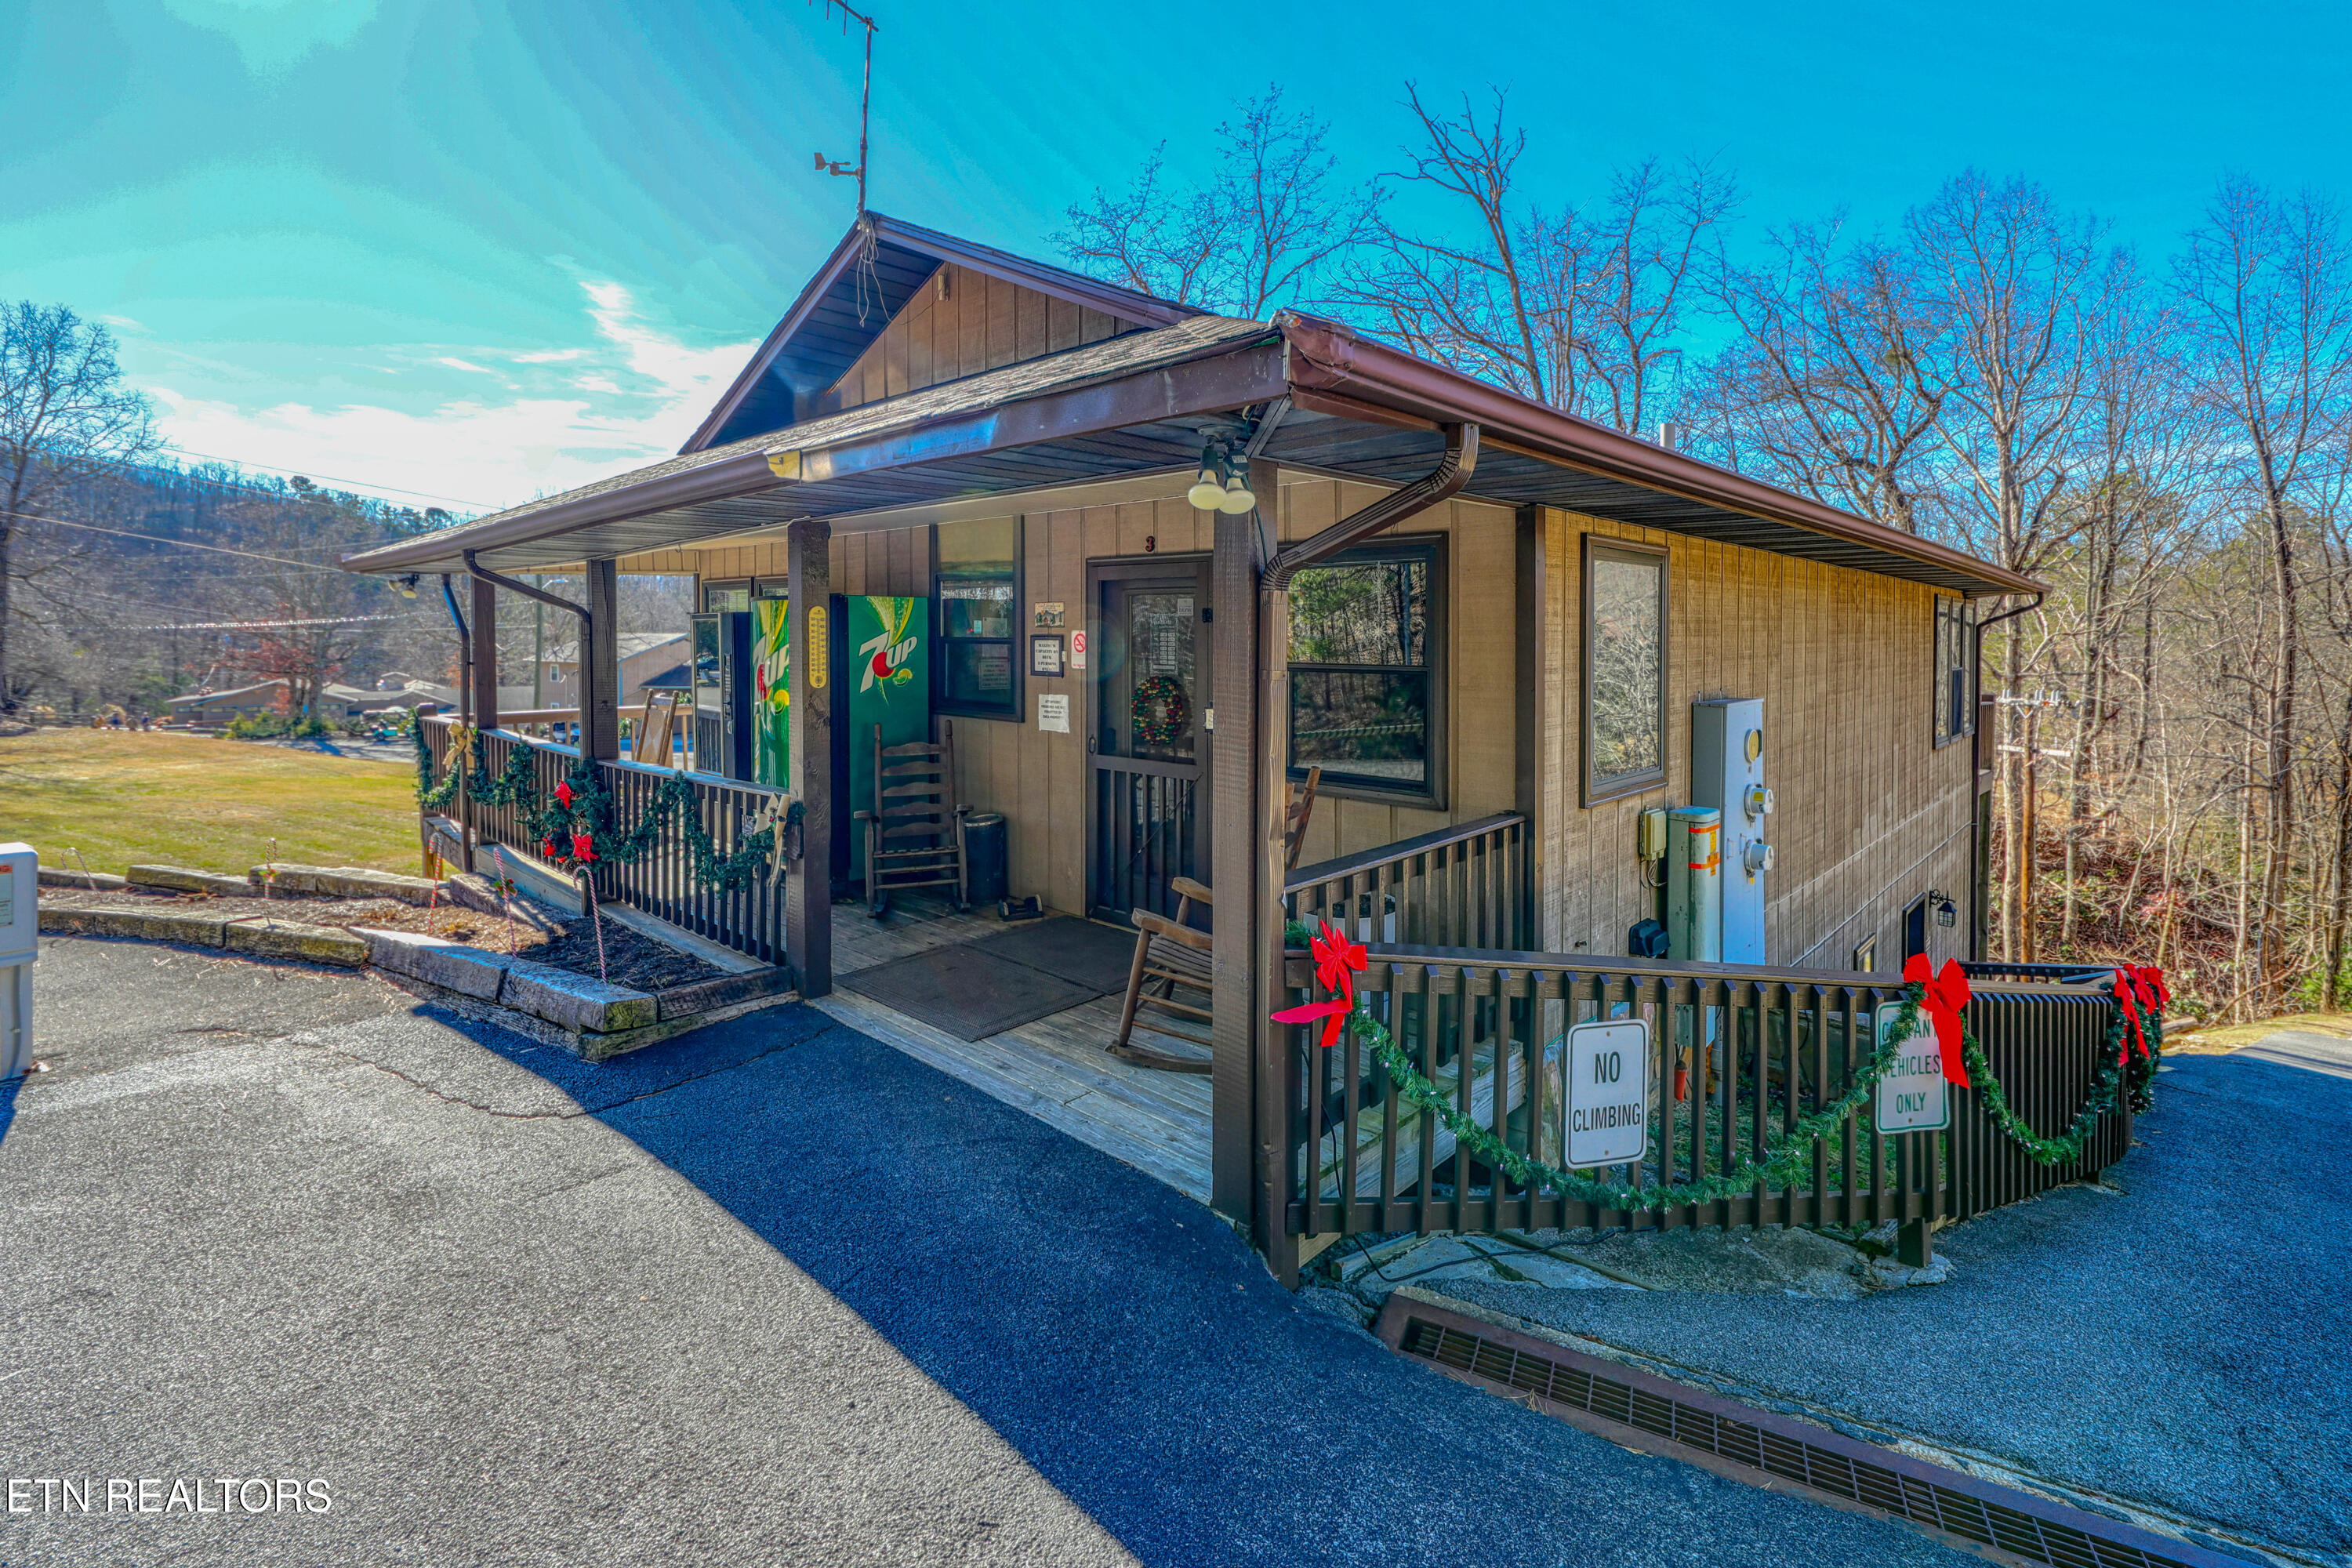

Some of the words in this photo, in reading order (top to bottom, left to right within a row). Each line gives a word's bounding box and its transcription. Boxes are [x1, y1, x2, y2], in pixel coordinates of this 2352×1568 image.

[1145, 536, 1155, 552] 3
[858, 630, 918, 694] 7UP
[1595, 1051, 1621, 1084] NO
[1885, 1054, 1940, 1078] EHICLES
[1896, 1092, 1926, 1114] ONLY
[1573, 1102, 1641, 1133] CLIMBING
